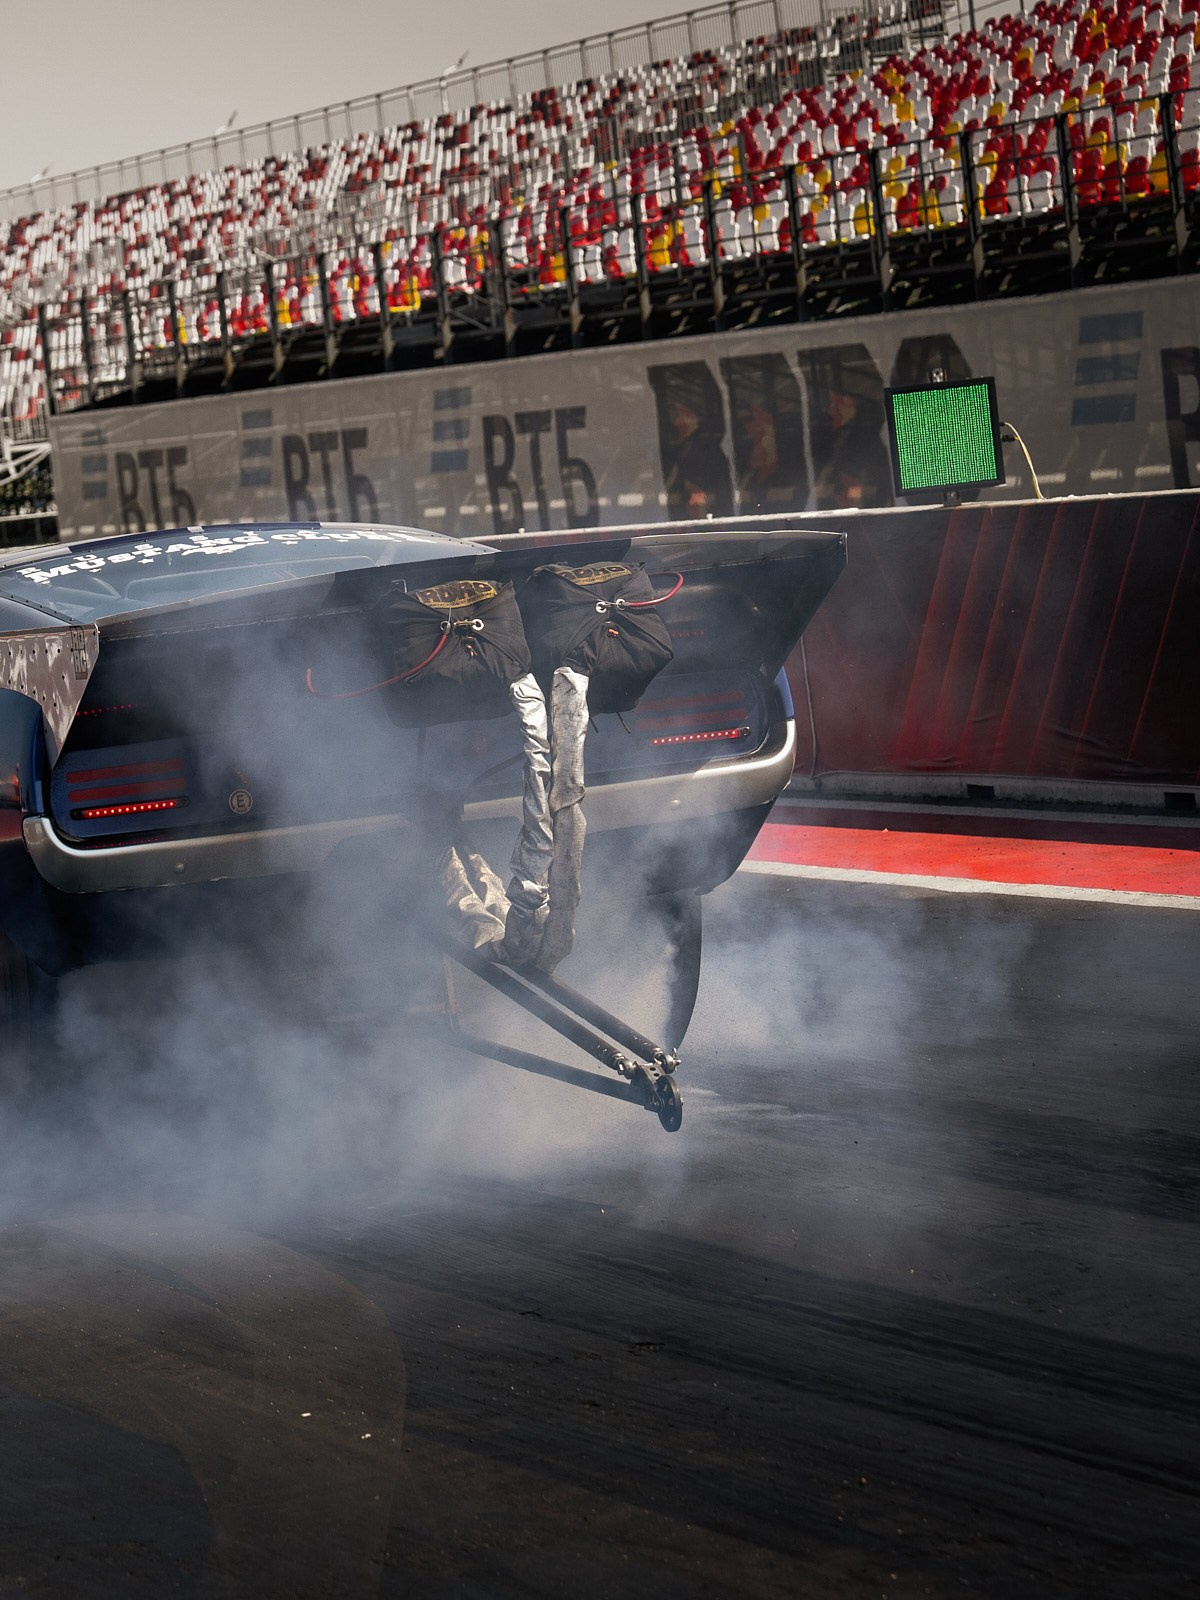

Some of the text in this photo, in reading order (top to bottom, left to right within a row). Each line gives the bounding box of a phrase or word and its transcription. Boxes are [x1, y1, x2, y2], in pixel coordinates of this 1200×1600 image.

[115, 447, 197, 531] ВТБ
[282, 428, 379, 524] ВТБ
[483, 407, 600, 534] ВТБ
